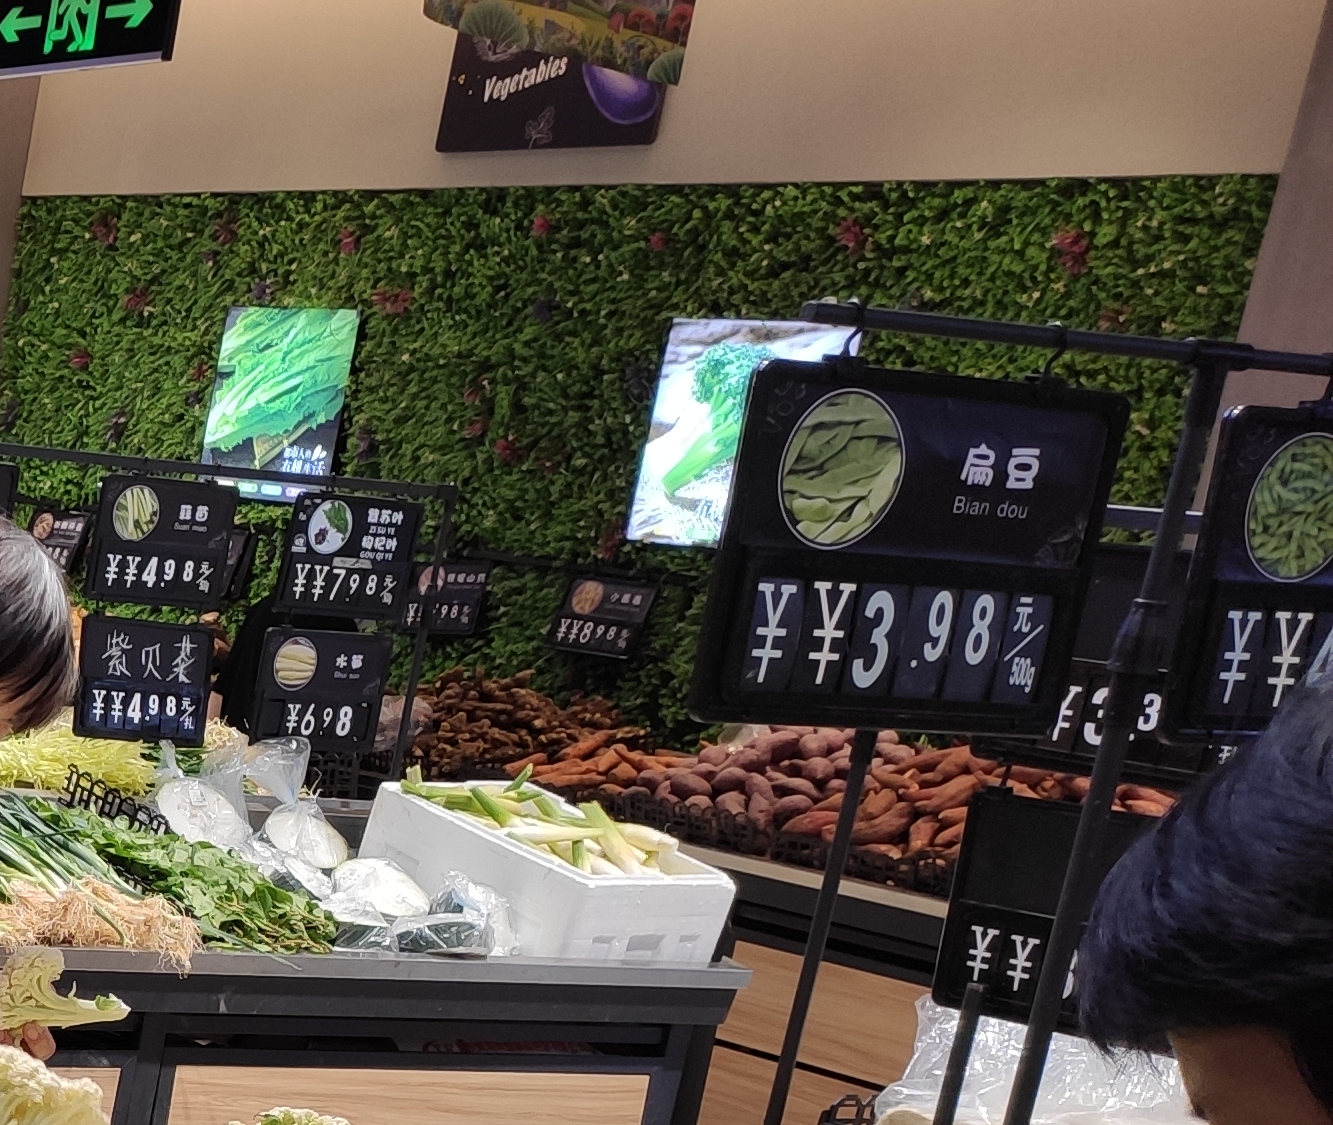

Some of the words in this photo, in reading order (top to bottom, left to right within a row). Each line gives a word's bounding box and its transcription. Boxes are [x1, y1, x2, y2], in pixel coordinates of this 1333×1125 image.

[484, 55, 568, 103] Vegetables
[960, 443, 1041, 489] 扁豆
[953, 496, 990, 516] Bian
[997, 501, 1028, 519] dou
[104, 553, 195, 588] ¥¥4.98
[293, 563, 378, 602] ¥¥7.98
[751, 580, 995, 689] ¥¥3.98
[101, 629, 199, 684] 紫贝菜
[92, 689, 177, 724] ¥¥4.98
[285, 702, 353, 737] ¥6.98
